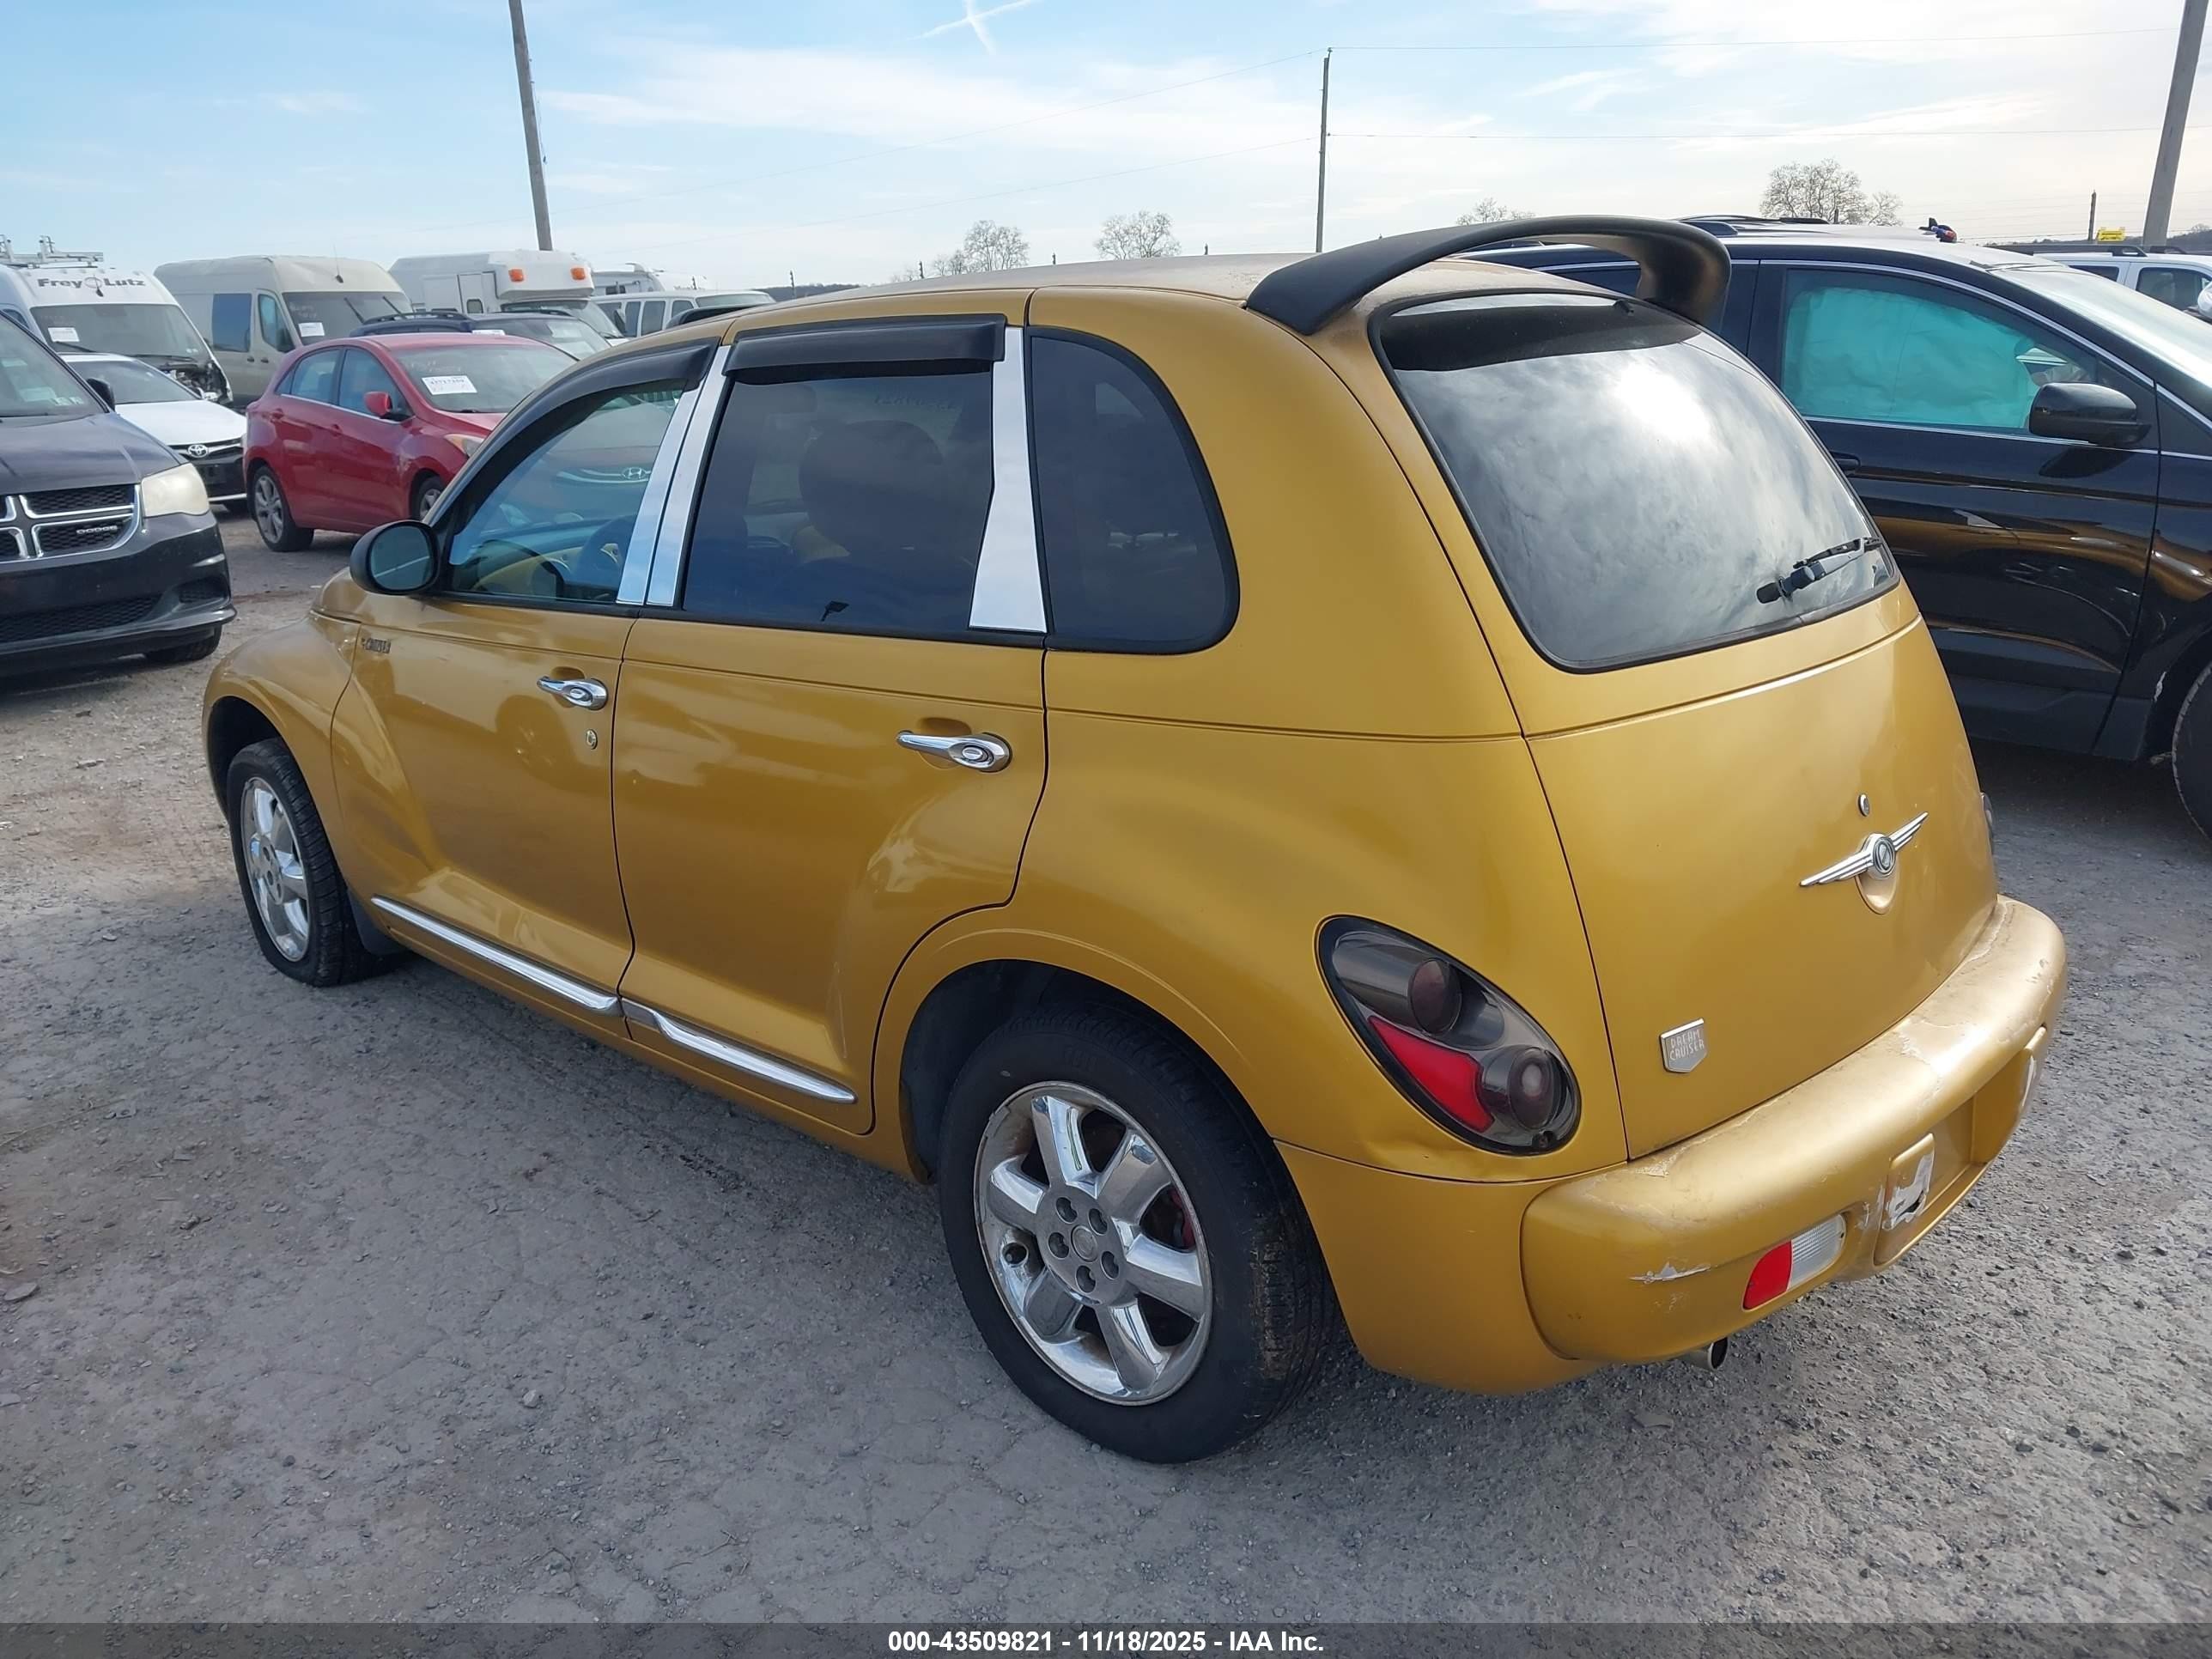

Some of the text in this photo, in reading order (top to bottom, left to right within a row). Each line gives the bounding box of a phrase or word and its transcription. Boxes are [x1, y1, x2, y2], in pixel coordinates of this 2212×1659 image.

[37, 277, 146, 289] Frey Lutz
[1670, 1029, 1701, 1048] DREAM
[1669, 1040, 1705, 1061] CRUISER
